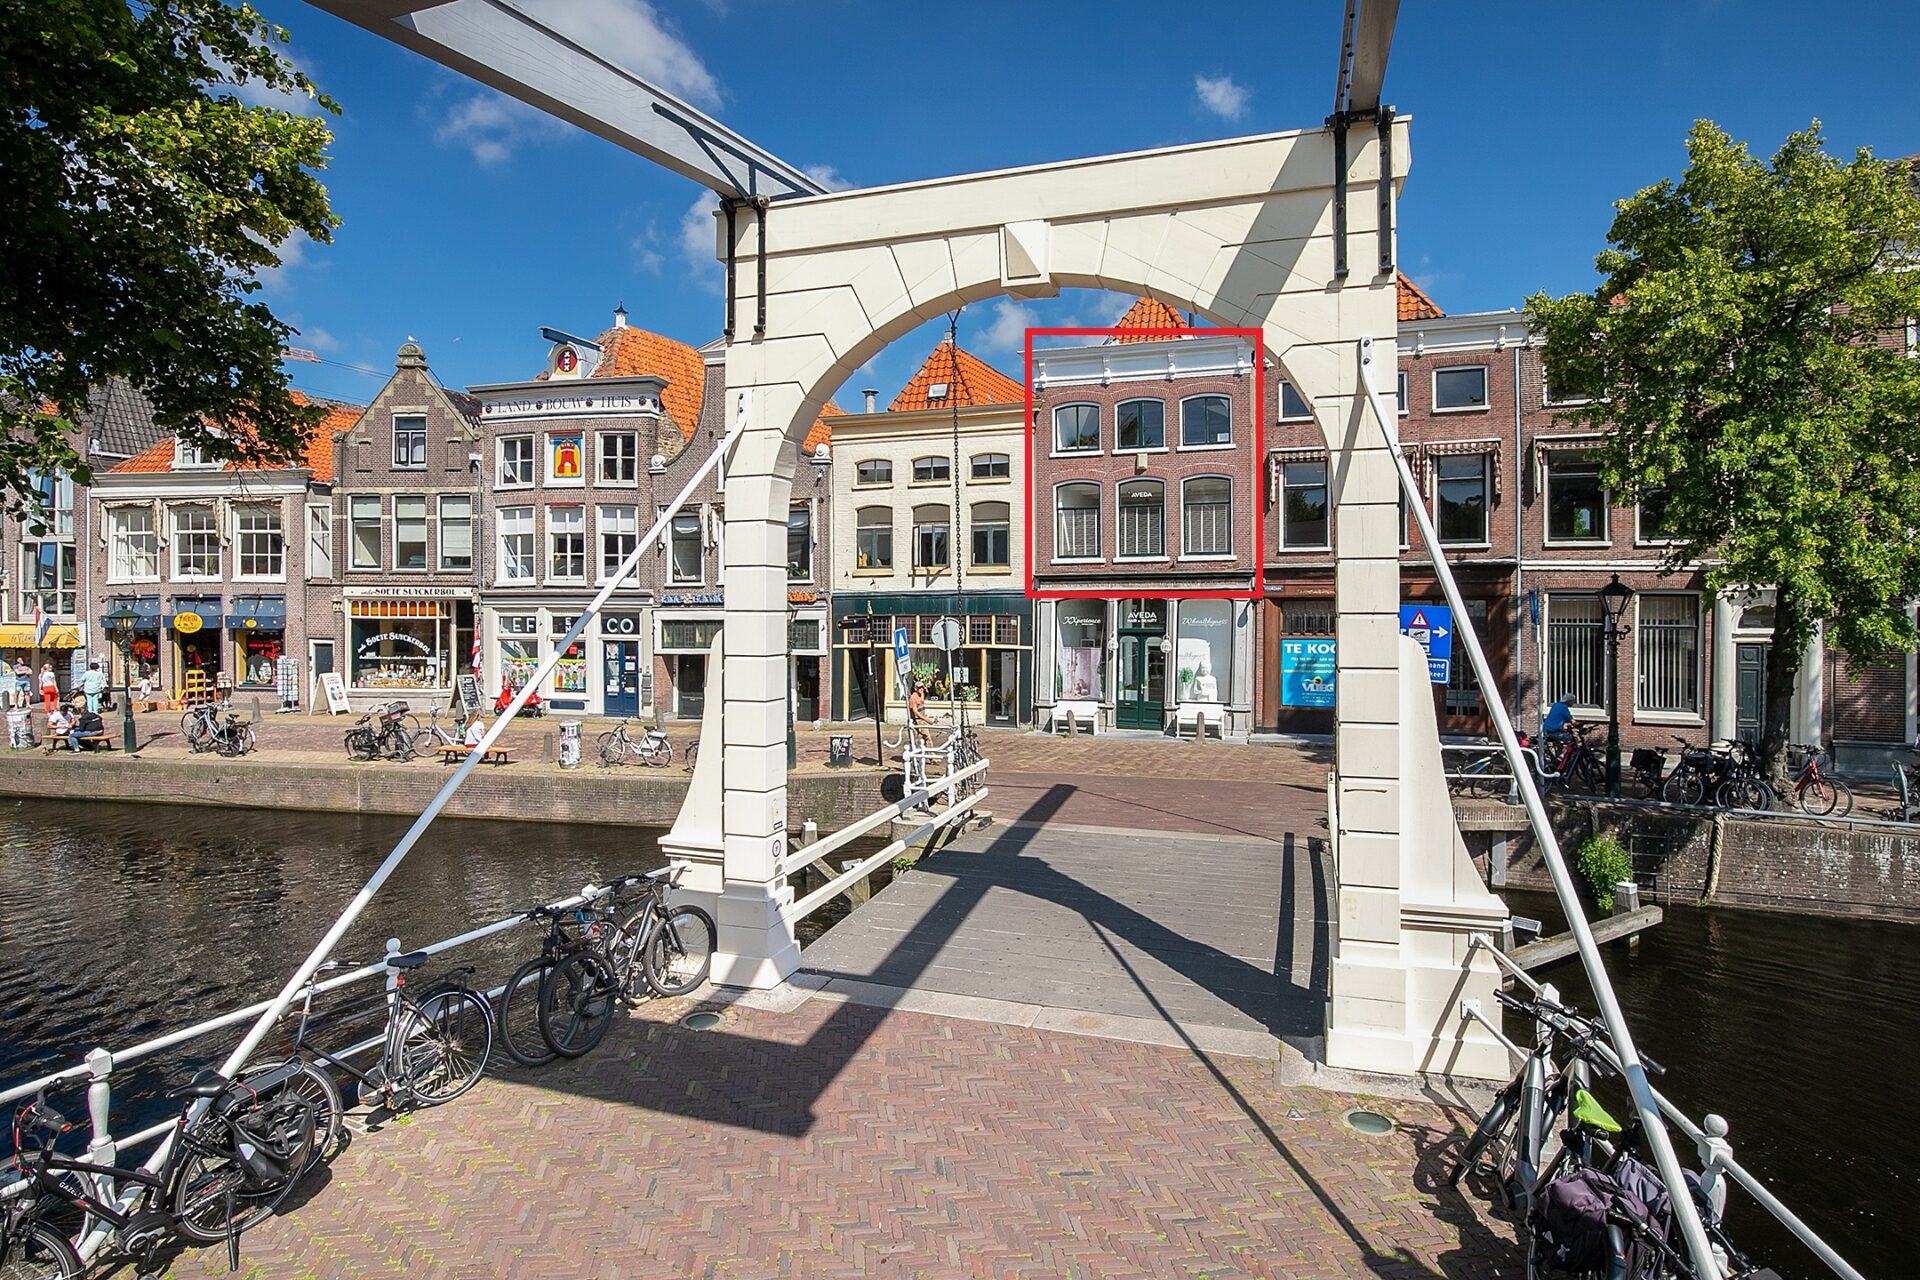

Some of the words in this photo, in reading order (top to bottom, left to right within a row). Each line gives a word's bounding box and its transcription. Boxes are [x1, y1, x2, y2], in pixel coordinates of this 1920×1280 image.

[498, 400, 531, 413] LAND
[546, 397, 583, 410] BOUW
[601, 396, 631, 407] HUIS
[1127, 611, 1157, 619] AVEDA
[606, 618, 634, 633] CO
[366, 632, 388, 646] SOETE
[1284, 643, 1302, 654] TE
[1302, 683, 1334, 692] VLIEG
